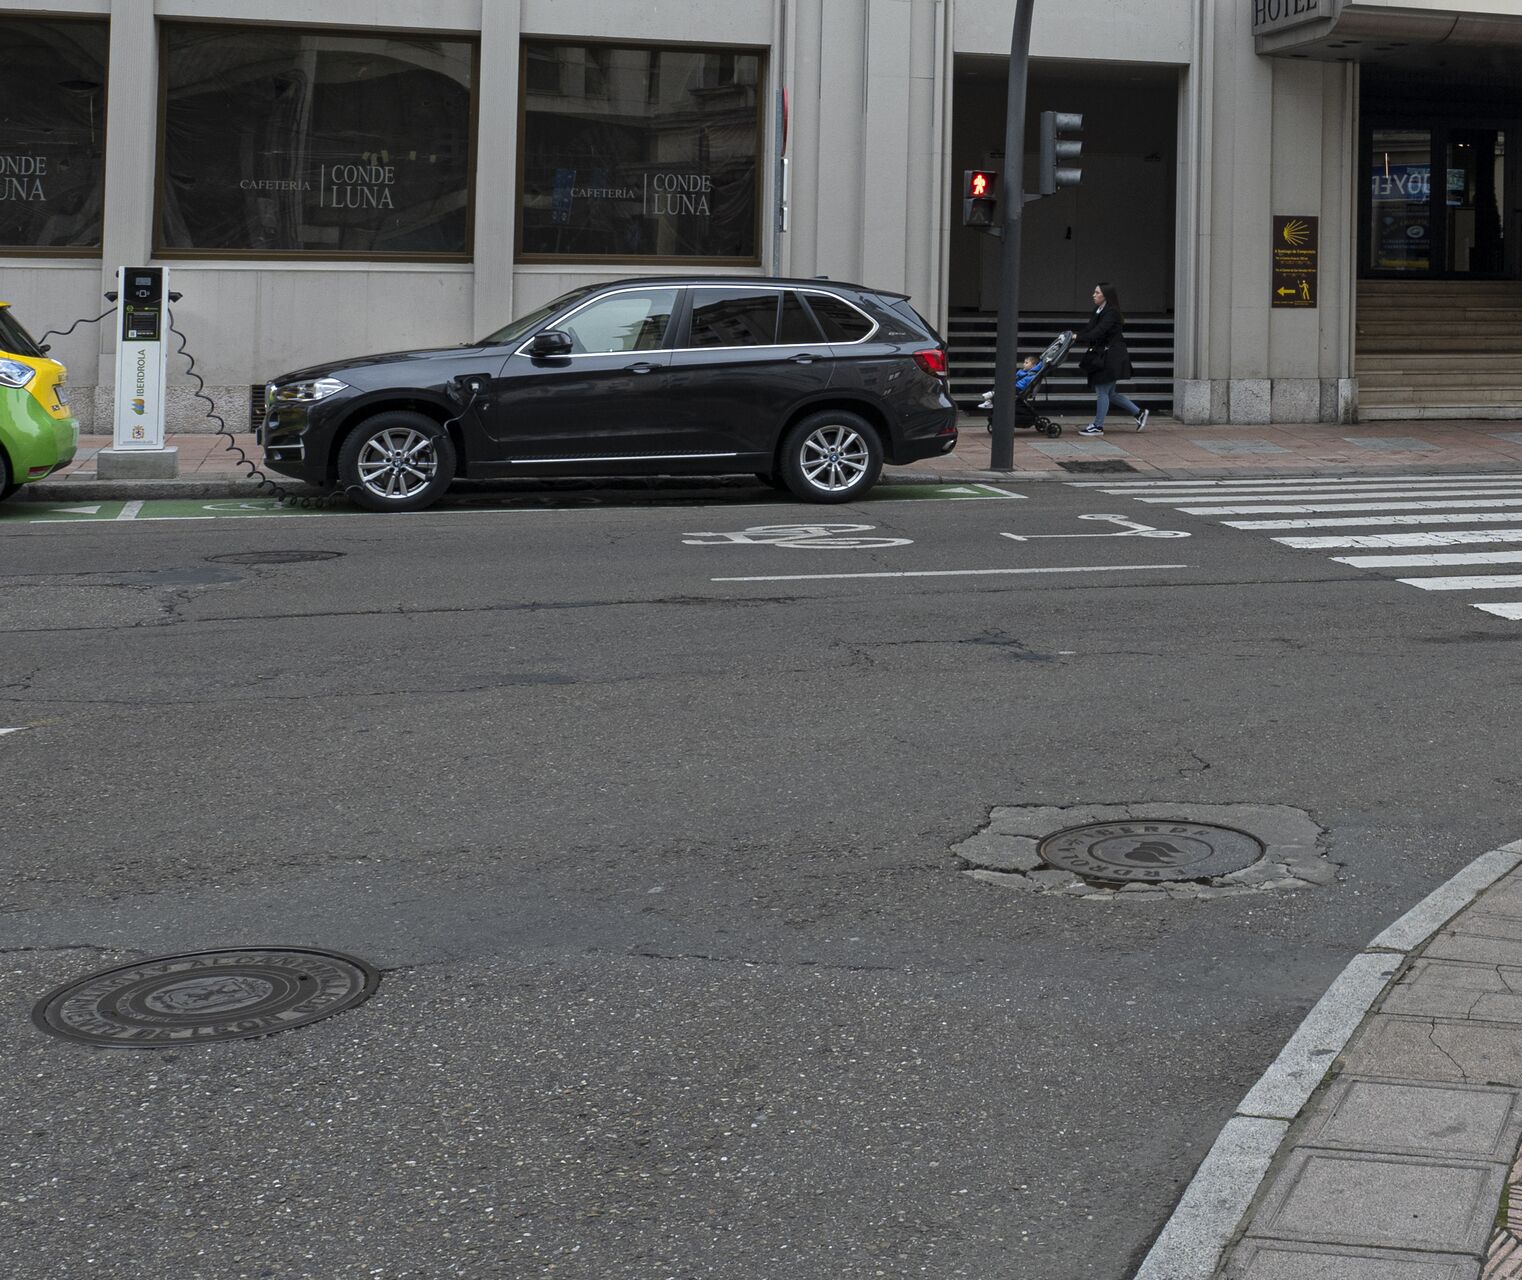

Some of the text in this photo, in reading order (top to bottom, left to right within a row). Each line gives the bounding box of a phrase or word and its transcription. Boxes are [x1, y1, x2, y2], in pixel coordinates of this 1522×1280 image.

[331, 165, 395, 184] CONDE
[653, 174, 712, 192] CONDE
[331, 186, 394, 209] LUNA
[571, 186, 635, 199] CAFETERÍA
[653, 194, 711, 216] LUNA
[136, 349, 146, 397] IBERDROLA
